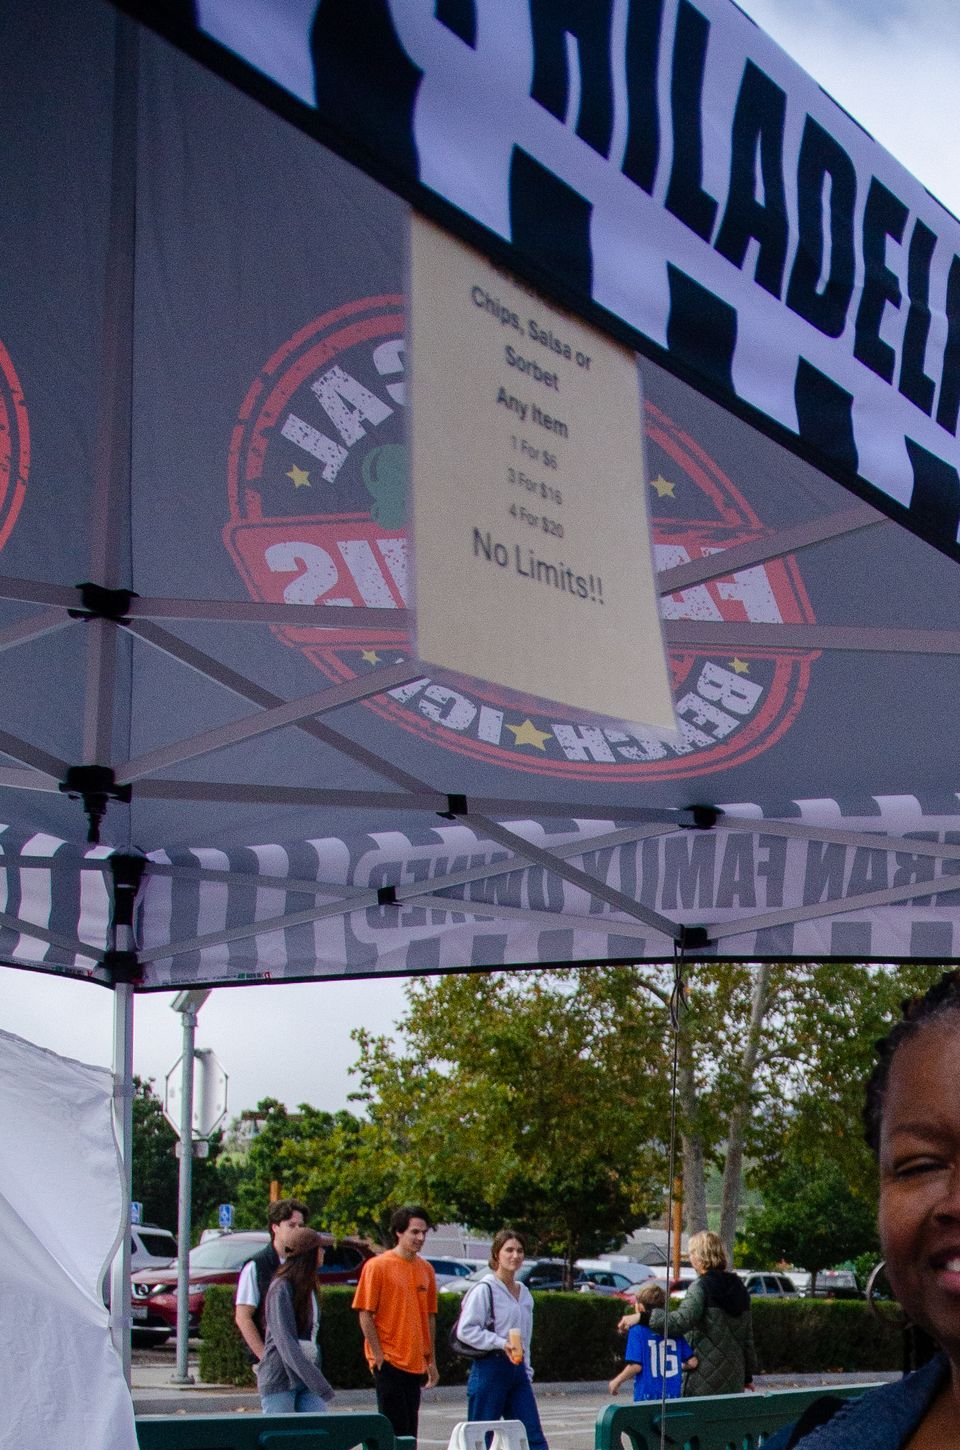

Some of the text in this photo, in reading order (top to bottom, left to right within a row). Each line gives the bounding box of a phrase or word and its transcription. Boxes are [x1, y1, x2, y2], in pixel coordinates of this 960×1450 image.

[471, 285, 592, 371] Chips, Salsa or
[504, 344, 560, 392] Sorbet
[497, 386, 569, 439] Any Item
[511, 435, 518, 450] 1
[521, 439, 539, 460] For
[508, 467, 516, 484] 3
[519, 472, 537, 493] For
[509, 503, 565, 538] 4 For $20
[472, 527, 604, 605] No Limits!!
[647, 1339, 679, 1378] 16
